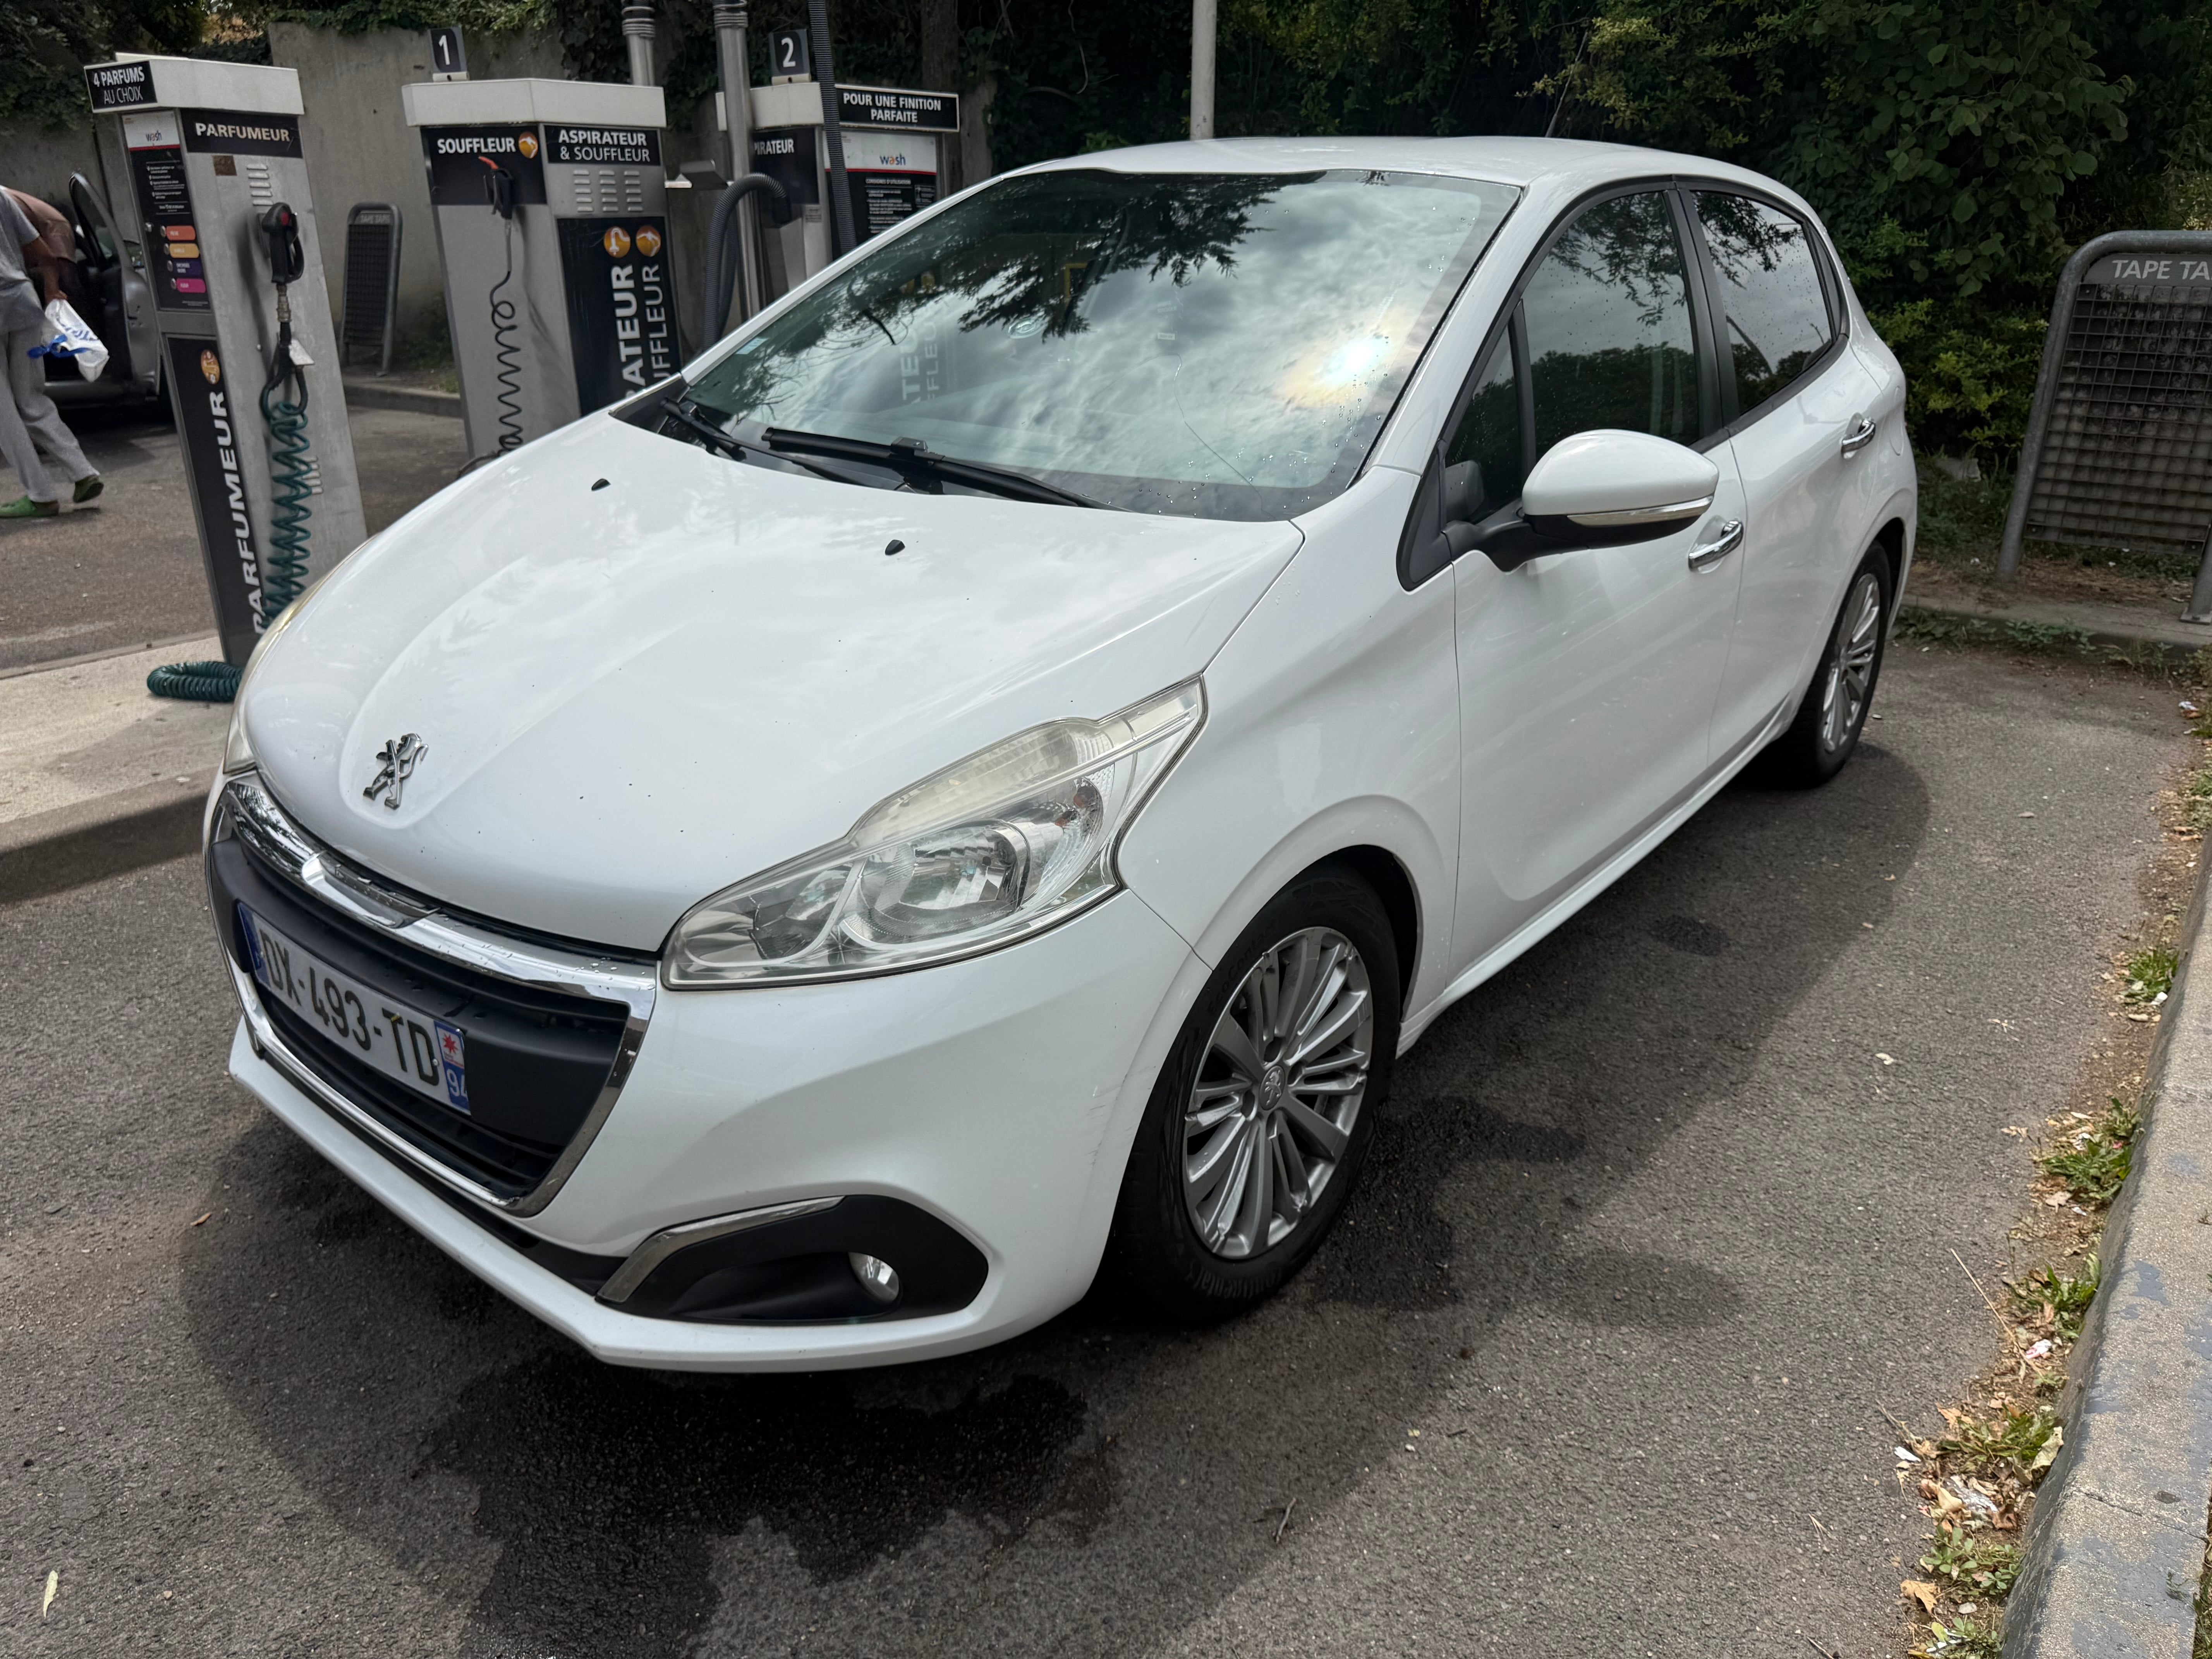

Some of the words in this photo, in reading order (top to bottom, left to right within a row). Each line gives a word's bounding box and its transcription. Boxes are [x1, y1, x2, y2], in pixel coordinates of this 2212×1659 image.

[438, 34, 450, 65] 1
[781, 37, 796, 68] 2
[93, 72, 100, 88] 4
[101, 66, 145, 87] PARFUMS
[104, 89, 116, 105] AU
[117, 86, 144, 103] CHOIX
[843, 92, 873, 106] POUR
[875, 95, 897, 108] UNE
[899, 97, 941, 112] FINITION
[870, 108, 918, 123] PARFAITE
[195, 122, 290, 141] PARFUMEUR
[558, 129, 647, 146] ASPIRATEUR
[437, 137, 516, 154] SOUFFLEUR
[560, 146, 570, 160] &
[574, 146, 651, 162] SOUFFLEUR
[879, 153, 907, 165] wash
[2112, 259, 2173, 280] TAPE
[2179, 261, 2212, 281] TA
[260, 929, 440, 1087] DX-493-TD
